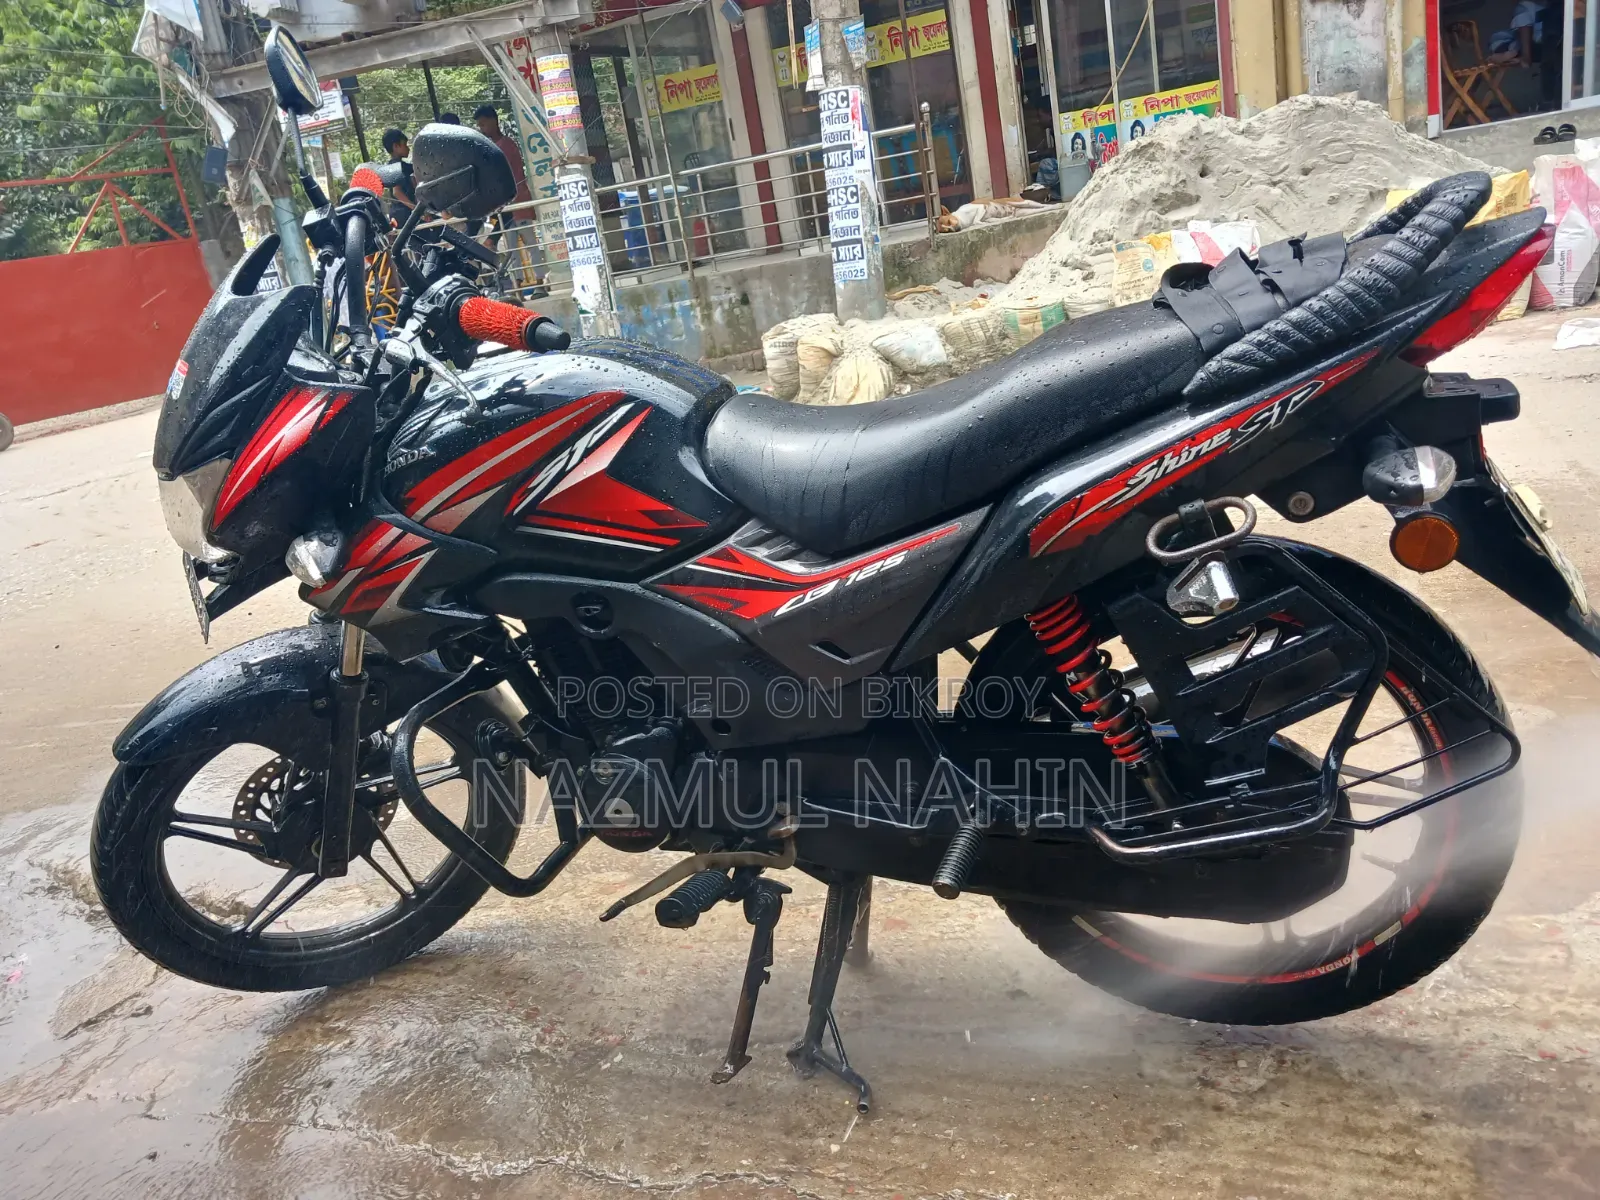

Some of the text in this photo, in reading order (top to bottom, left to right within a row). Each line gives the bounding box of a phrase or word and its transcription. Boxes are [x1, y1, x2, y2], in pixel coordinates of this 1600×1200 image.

[1142, 93, 1181, 114] নিপা
[383, 445, 437, 478] HONDA
[1105, 427, 1233, 511] Shine
[771, 548, 911, 619] CB 125
